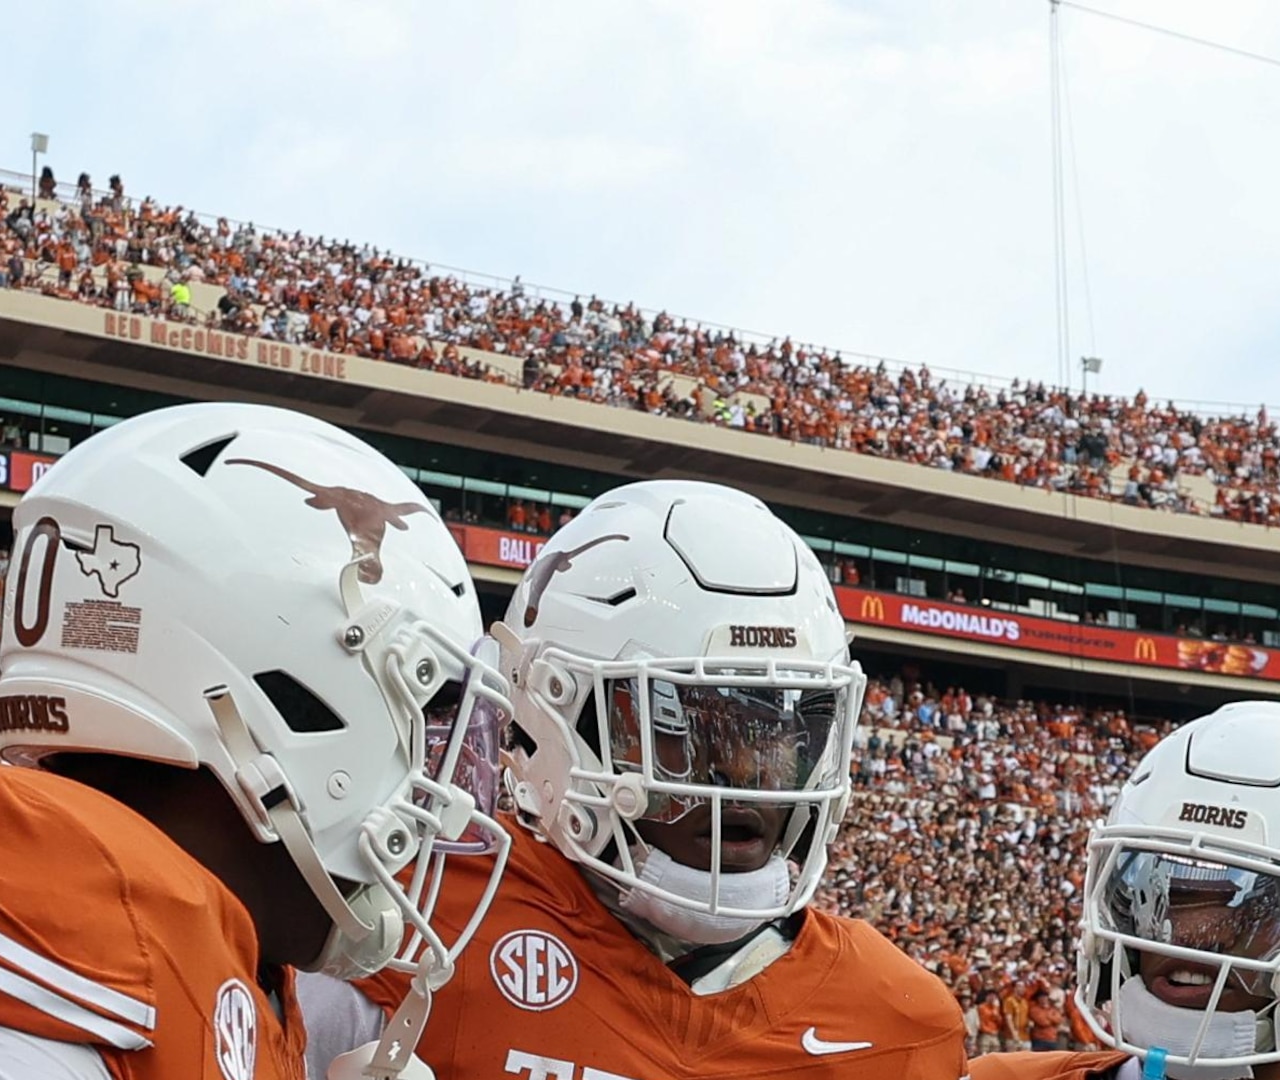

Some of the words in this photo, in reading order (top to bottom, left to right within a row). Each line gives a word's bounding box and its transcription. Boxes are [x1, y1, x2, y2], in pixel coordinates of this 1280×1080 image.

[104, 312, 141, 340] RED
[257, 342, 292, 369] RED
[300, 351, 347, 379] ZONE
[499, 536, 532, 565] BALL
[729, 625, 797, 649] HORNS
[901, 603, 1020, 641] McDONALD'S
[1179, 802, 1249, 830] HORNS
[499, 936, 574, 1004] SEC
